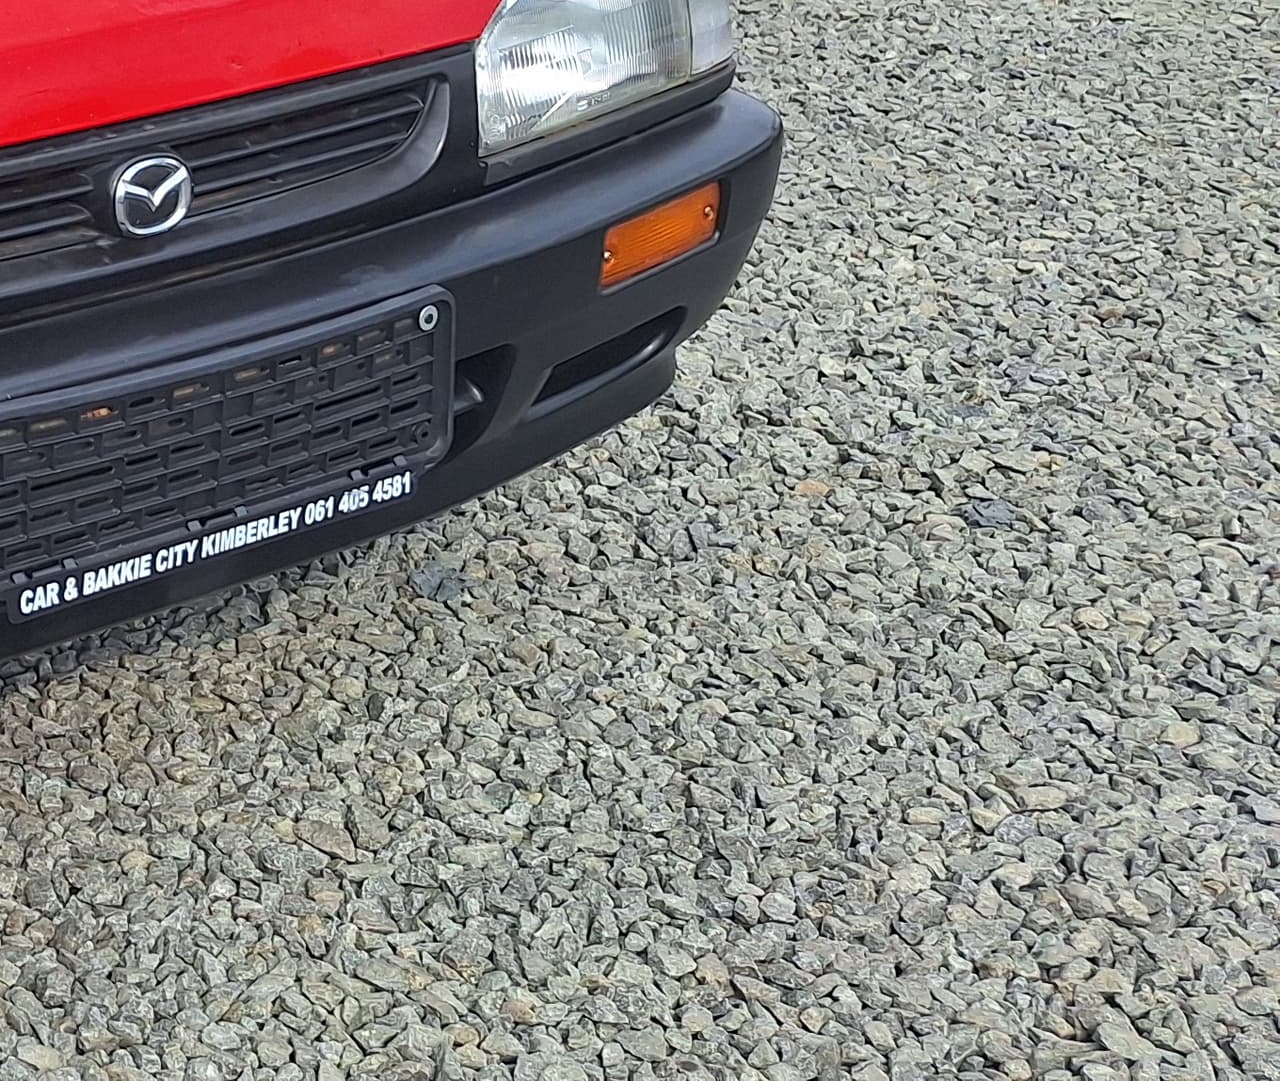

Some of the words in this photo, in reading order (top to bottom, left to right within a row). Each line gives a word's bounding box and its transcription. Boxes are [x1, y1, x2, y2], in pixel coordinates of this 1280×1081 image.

[20, 581, 60, 614] CAR
[63, 578, 79, 600] &
[82, 553, 152, 597] BAKKIE
[155, 540, 199, 573] CITY
[201, 507, 302, 558] KIMBERLEY
[304, 496, 335, 525] 061
[338, 487, 369, 513] 405
[372, 471, 412, 504] 4581
